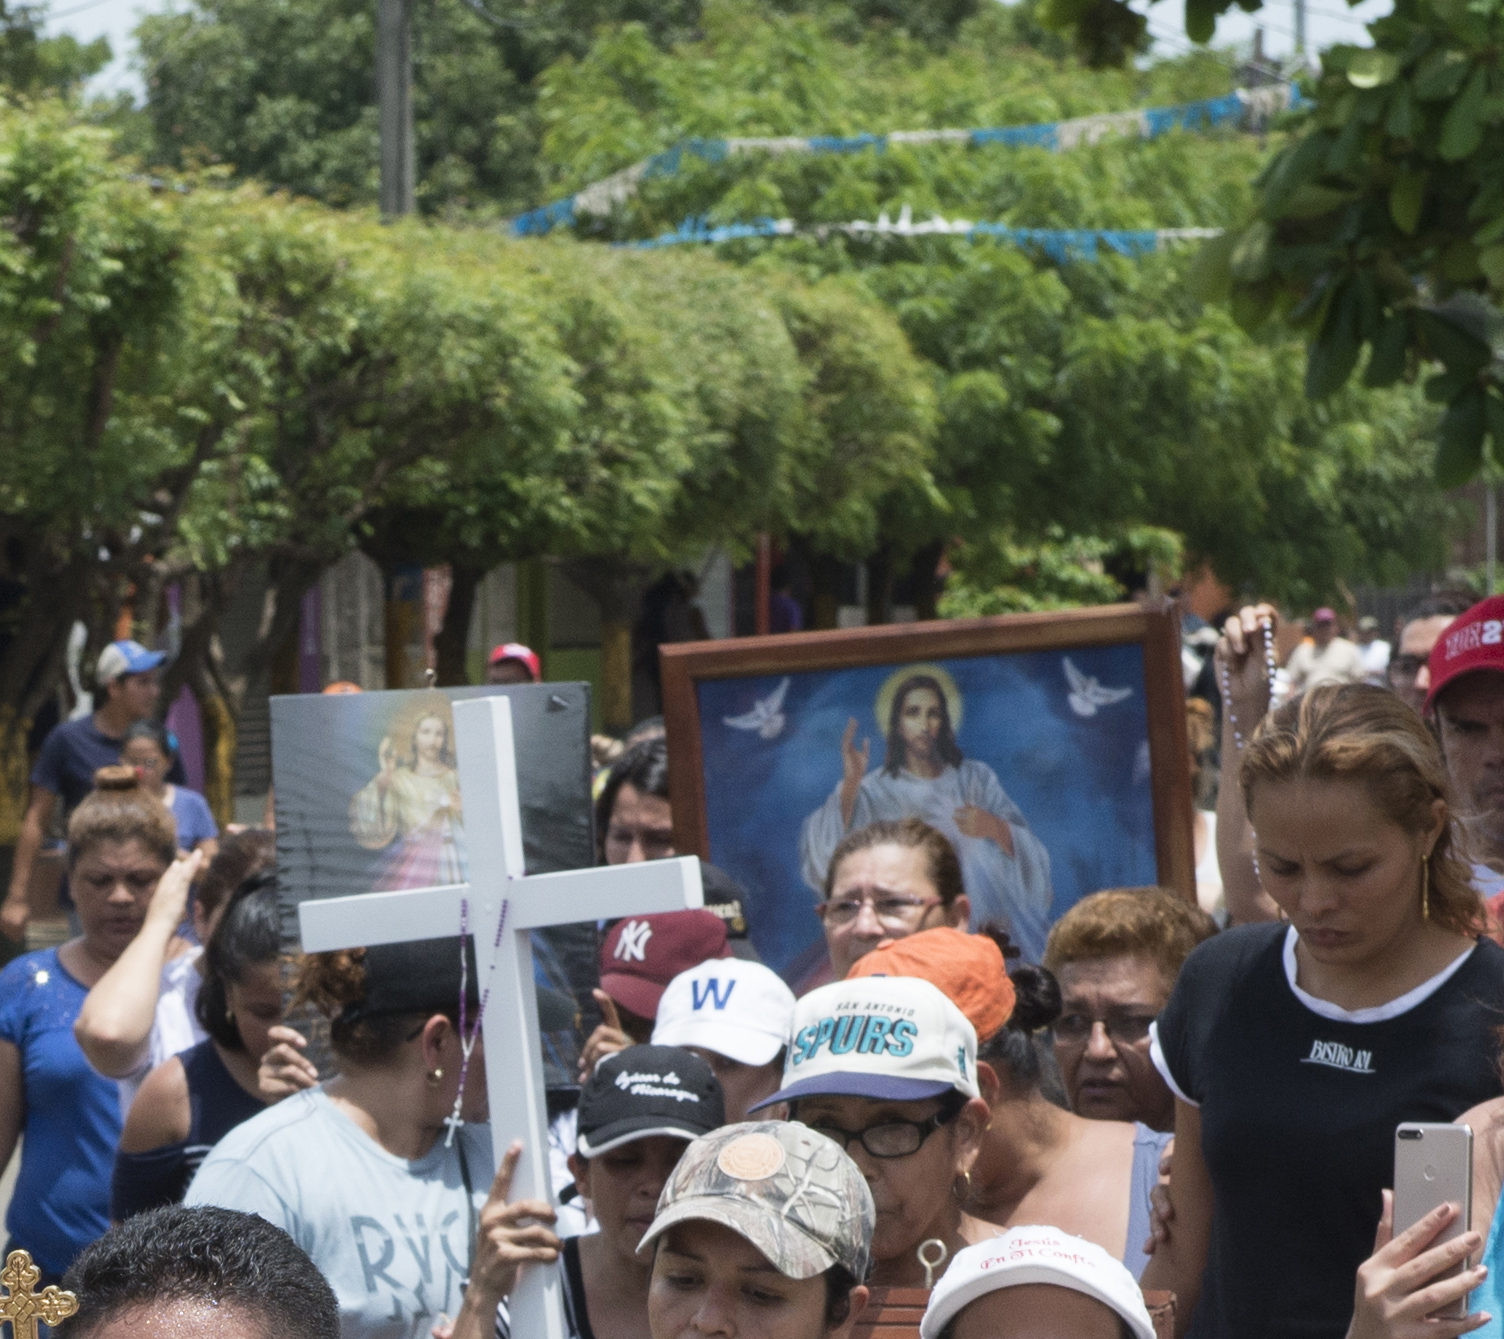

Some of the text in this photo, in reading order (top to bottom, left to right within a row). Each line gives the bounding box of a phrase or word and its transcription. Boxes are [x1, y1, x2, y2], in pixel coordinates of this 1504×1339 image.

[692, 977, 736, 1011] W
[835, 1001, 916, 1017] SAN ANTONIO
[792, 1014, 919, 1066] SPURS
